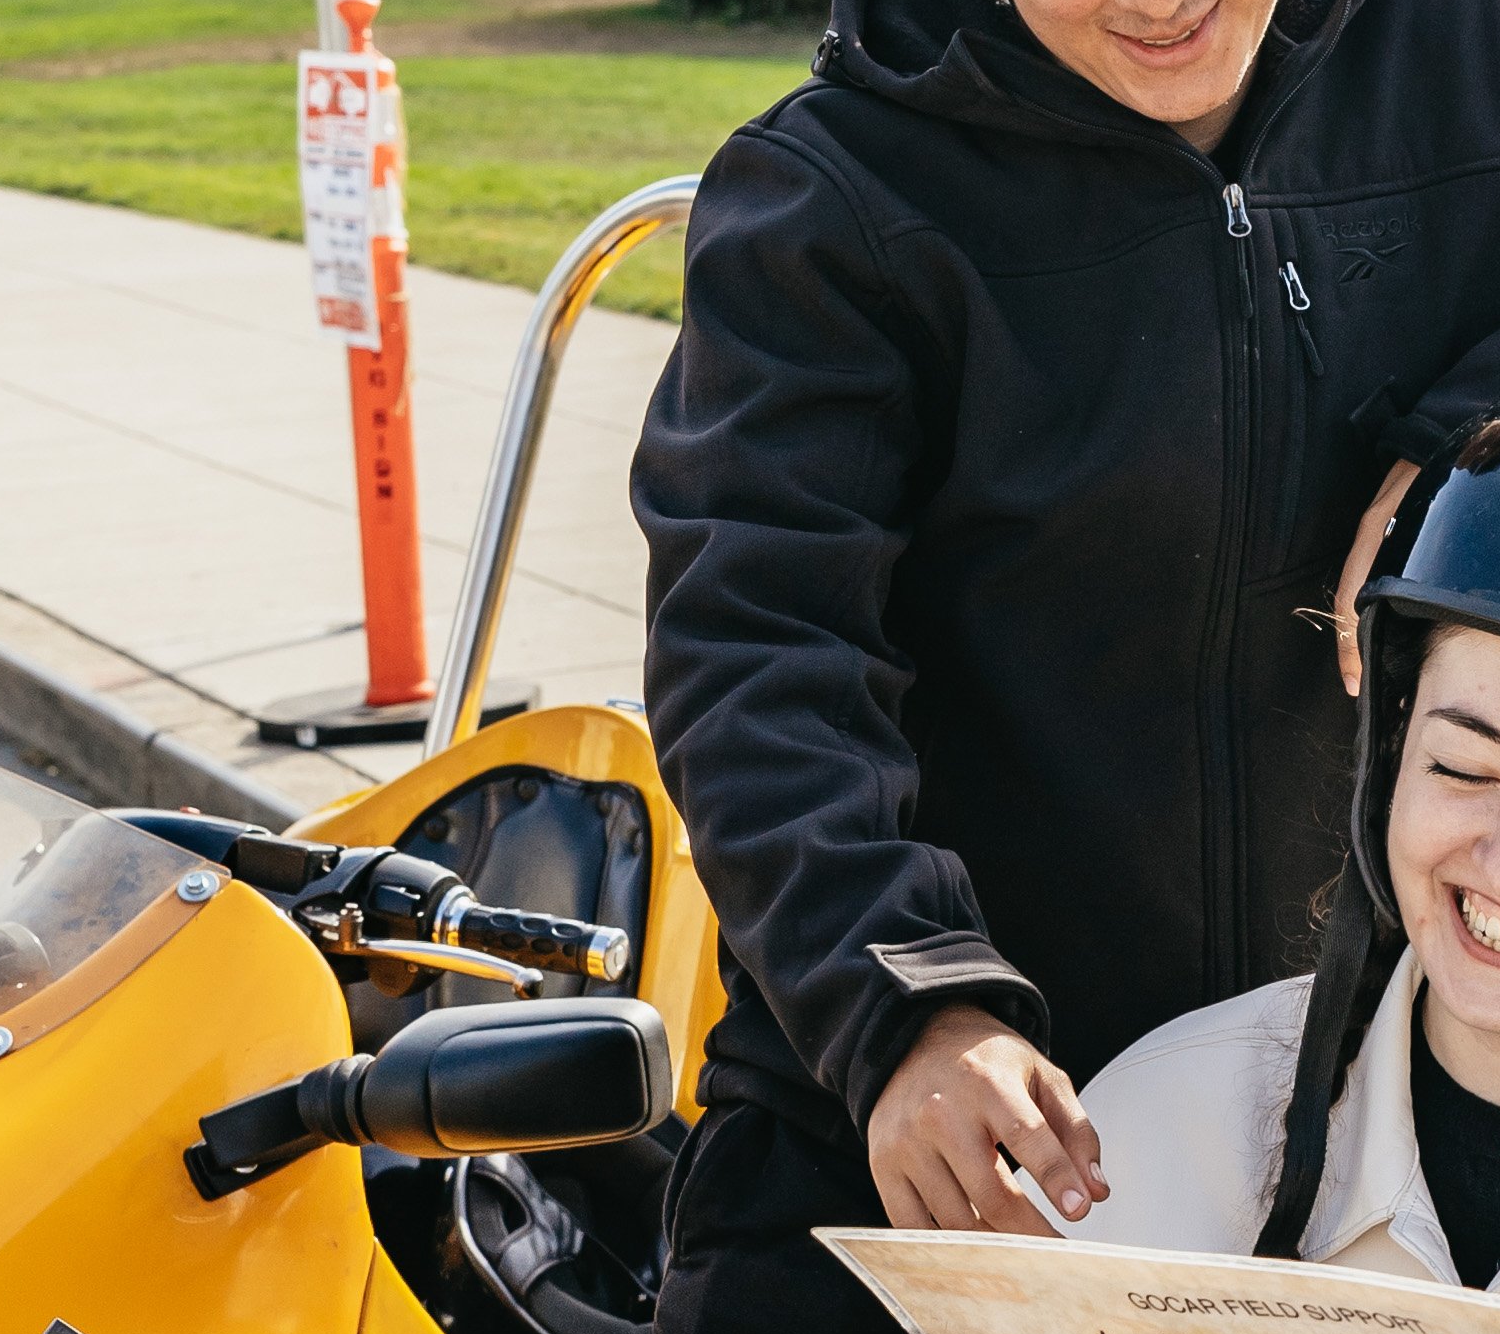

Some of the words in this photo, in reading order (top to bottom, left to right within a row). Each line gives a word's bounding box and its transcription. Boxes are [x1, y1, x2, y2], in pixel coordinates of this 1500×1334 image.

[1317, 213, 1422, 245] Reebok
[1126, 1291, 1221, 1316] GOCAR
[1222, 1298, 1300, 1319] FIELD
